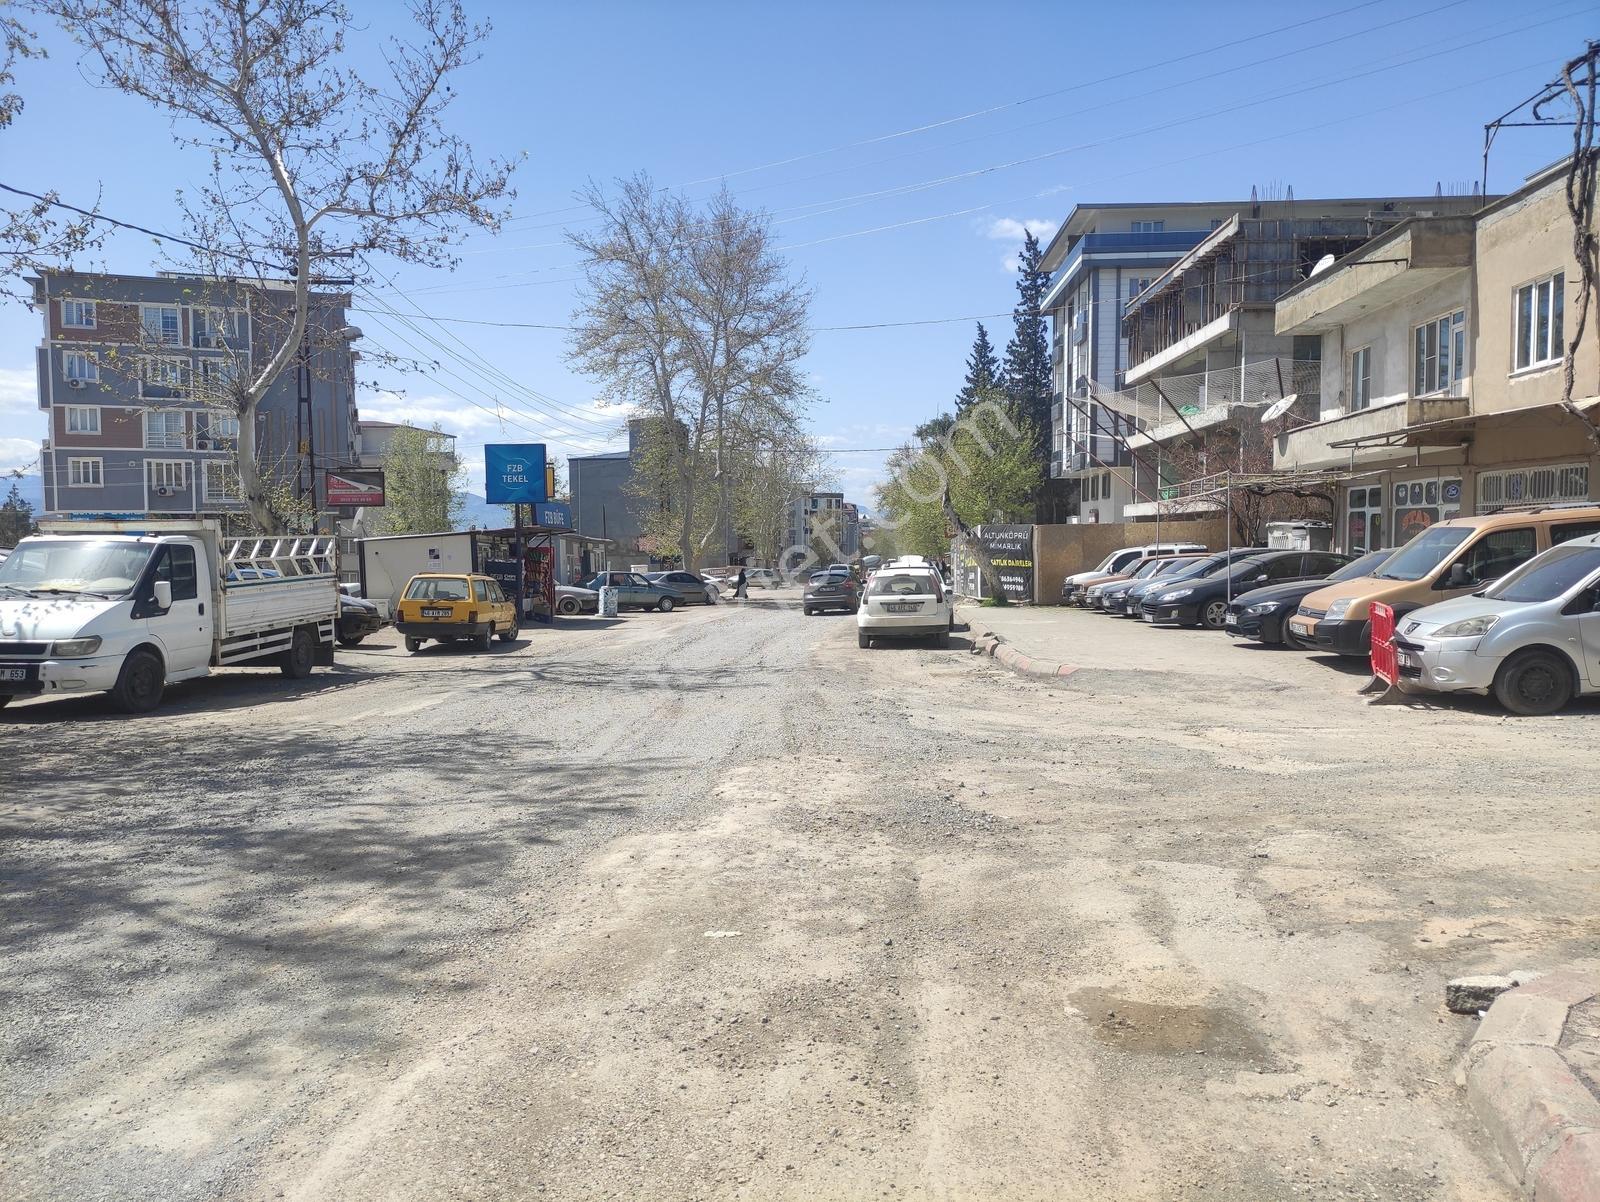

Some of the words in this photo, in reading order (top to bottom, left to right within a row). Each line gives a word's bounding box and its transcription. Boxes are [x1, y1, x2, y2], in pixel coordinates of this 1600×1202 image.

[507, 464, 523, 473] FZB
[502, 475, 529, 483] TEKEL
[984, 530, 1029, 540] ALTUNKÖPRÜ
[10, 670, 25, 679] 653
